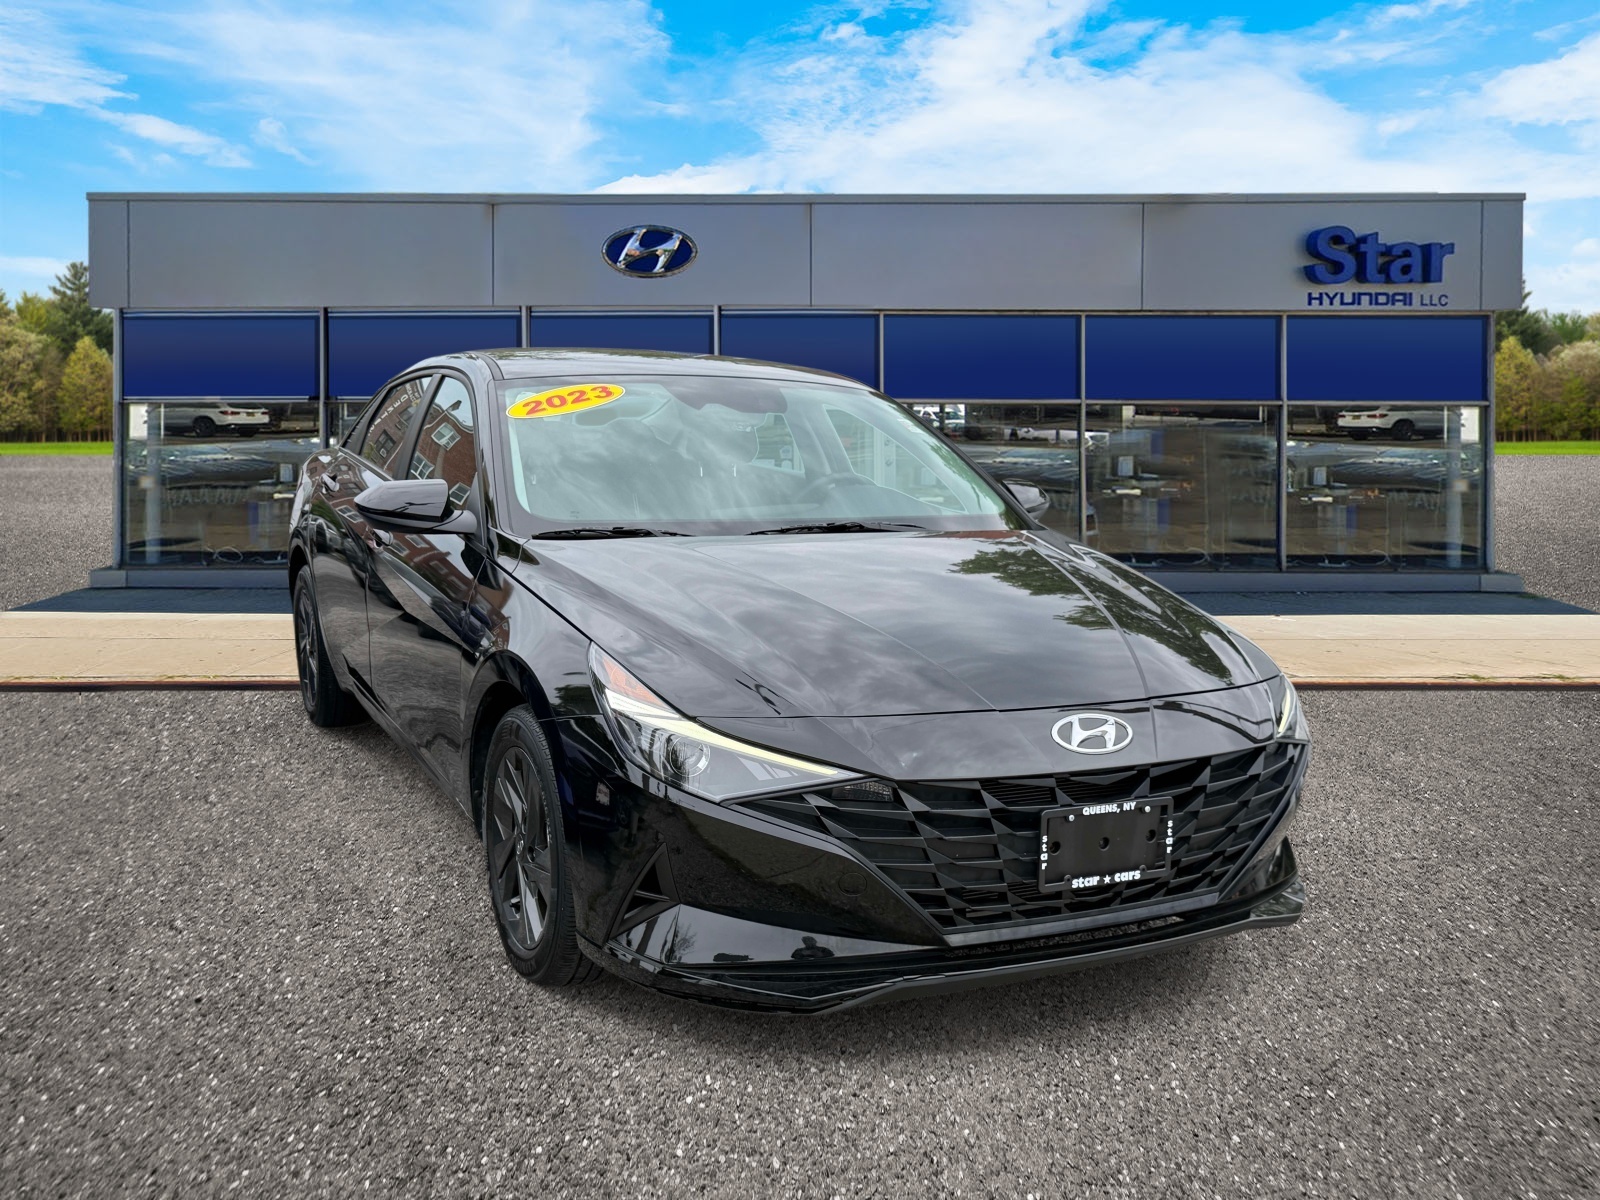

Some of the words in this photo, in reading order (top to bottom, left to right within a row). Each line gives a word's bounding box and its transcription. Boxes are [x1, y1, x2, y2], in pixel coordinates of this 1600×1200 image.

[1303, 226, 1455, 284] Star
[1307, 292, 1413, 306] HYUNDAI
[1420, 294, 1448, 307] LLC
[522, 386, 615, 416] 2023
[1082, 803, 1121, 816] QUEENS,
[1123, 801, 1137, 811] NY
[1071, 875, 1100, 889] star
[1114, 870, 1141, 883] cars
